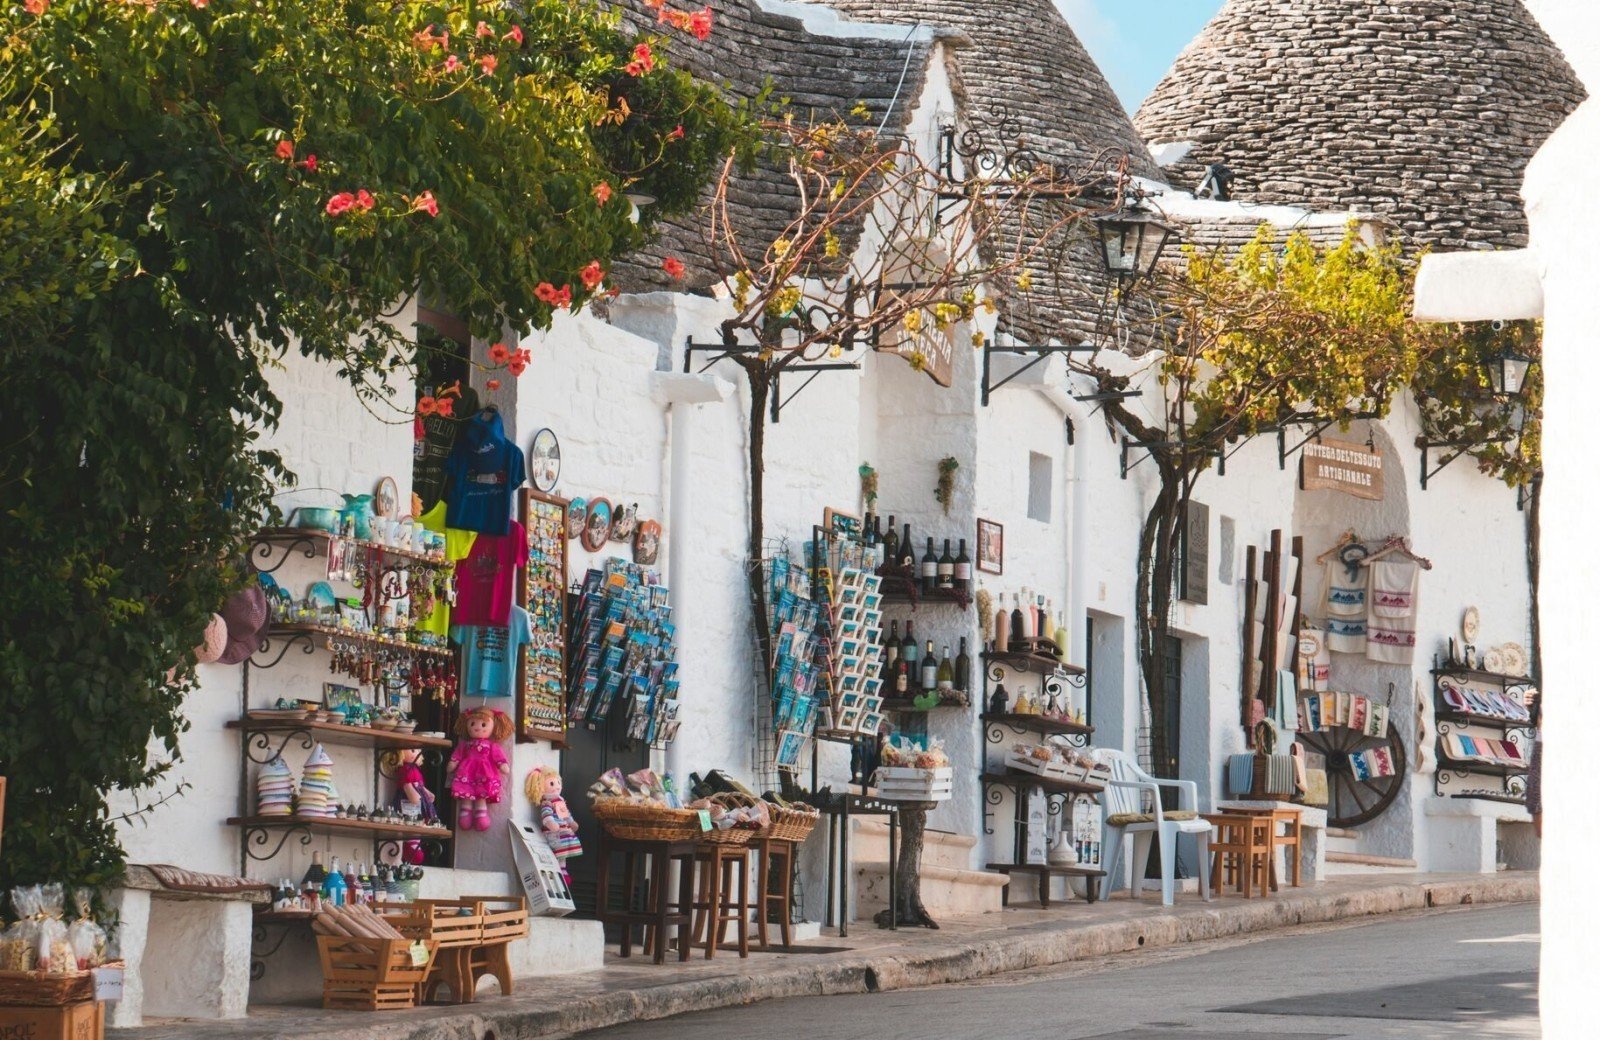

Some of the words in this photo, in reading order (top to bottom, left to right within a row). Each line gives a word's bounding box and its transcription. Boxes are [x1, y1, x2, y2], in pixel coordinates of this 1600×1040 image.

[897, 331, 937, 370] ENOECA
[1303, 443, 1335, 459] BOTTEGA
[1318, 465, 1371, 486] ARTIGIANALE
